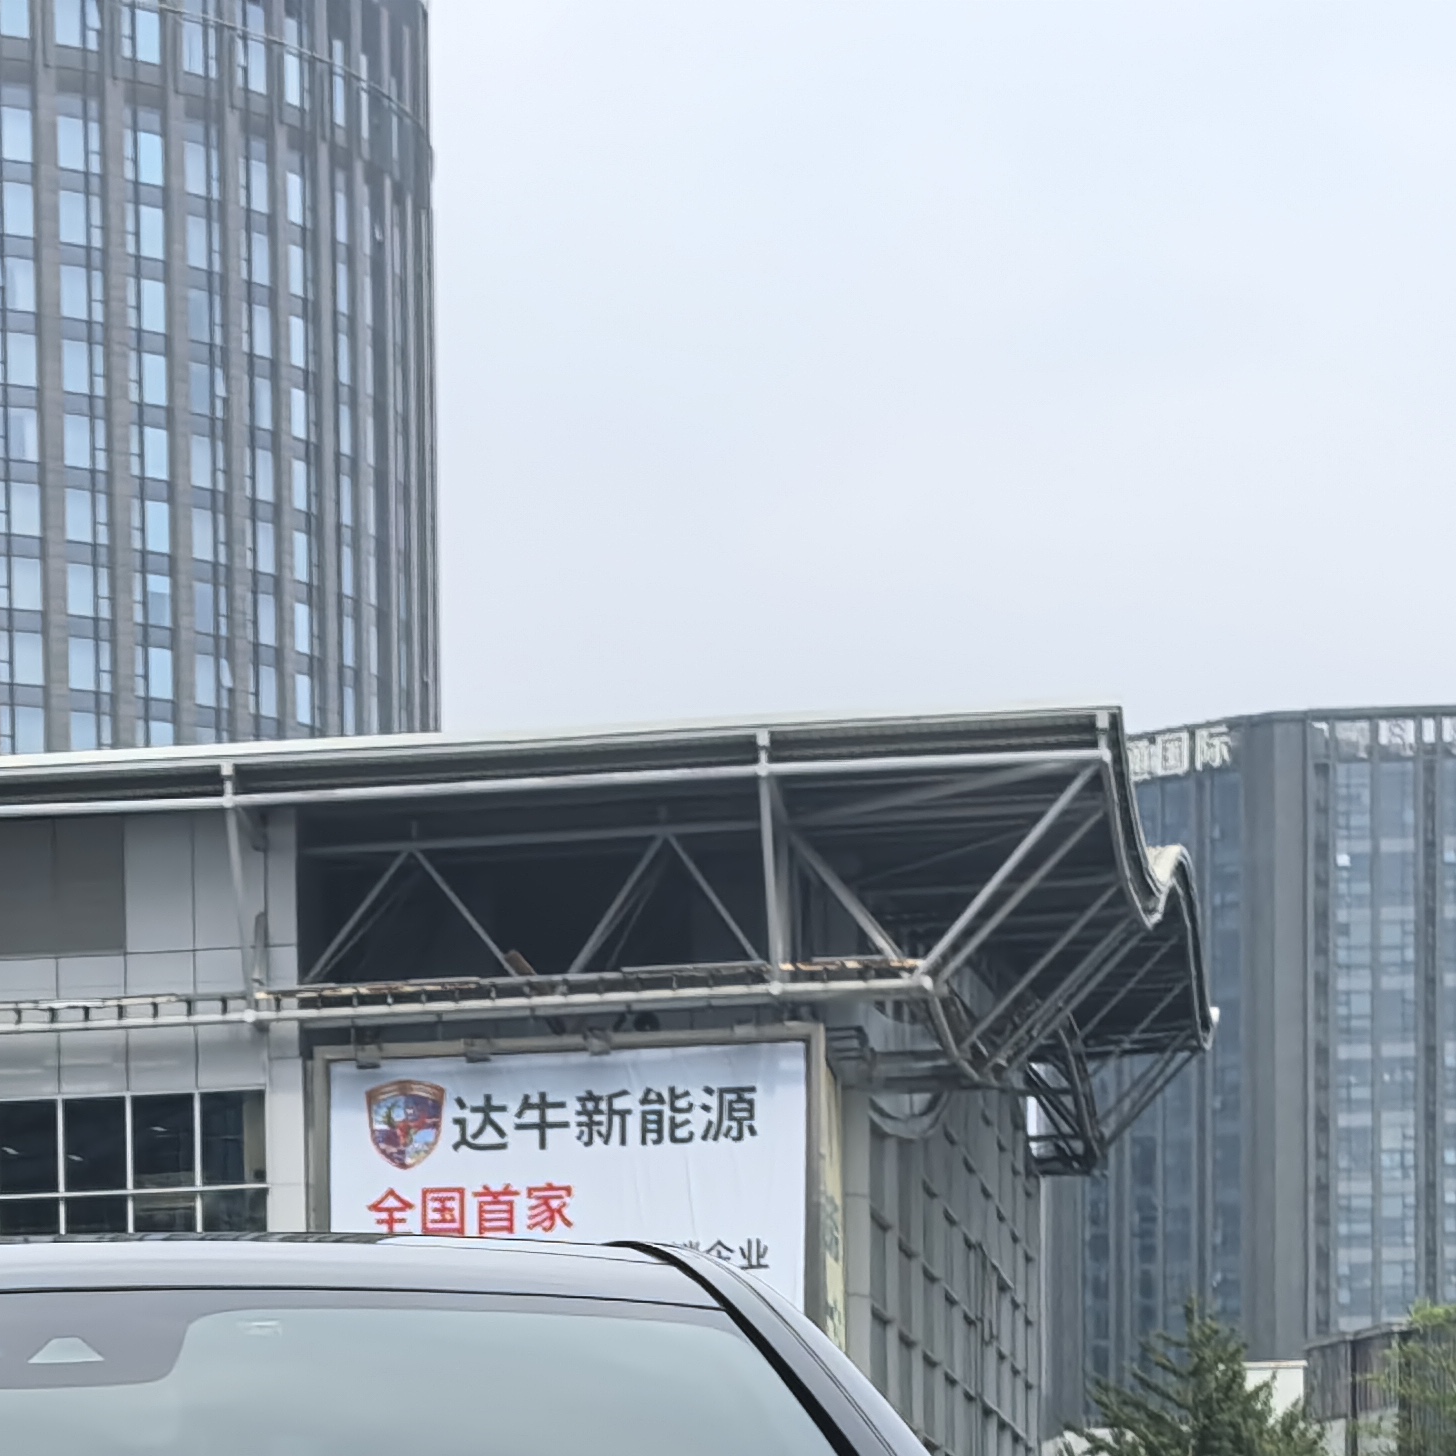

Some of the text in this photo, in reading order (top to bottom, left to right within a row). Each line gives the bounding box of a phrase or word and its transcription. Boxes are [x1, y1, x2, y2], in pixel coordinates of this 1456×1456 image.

[451, 1085, 758, 1152] 达牛新能源
[366, 1183, 575, 1236] 全国首家
